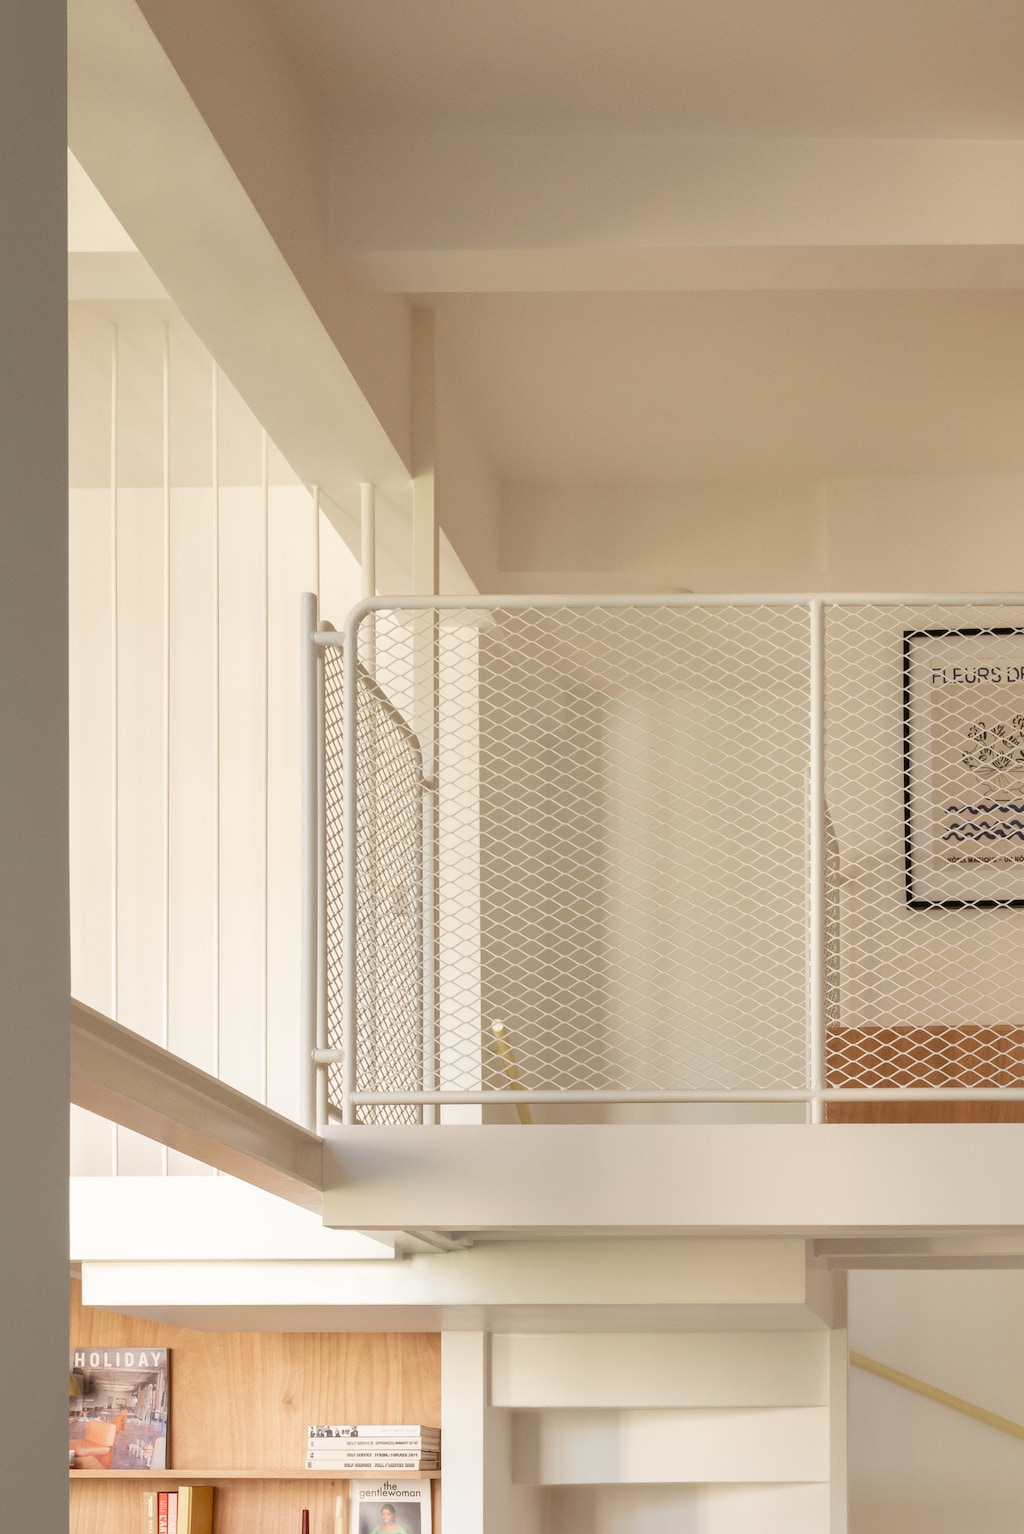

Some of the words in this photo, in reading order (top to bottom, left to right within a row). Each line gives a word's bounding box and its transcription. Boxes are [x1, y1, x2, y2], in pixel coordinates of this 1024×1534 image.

[932, 666, 1001, 684] FLEURS
[74, 1352, 161, 1367] HOLIDAY
[383, 1480, 397, 1490] the
[359, 1487, 421, 1499] gentlewoman
